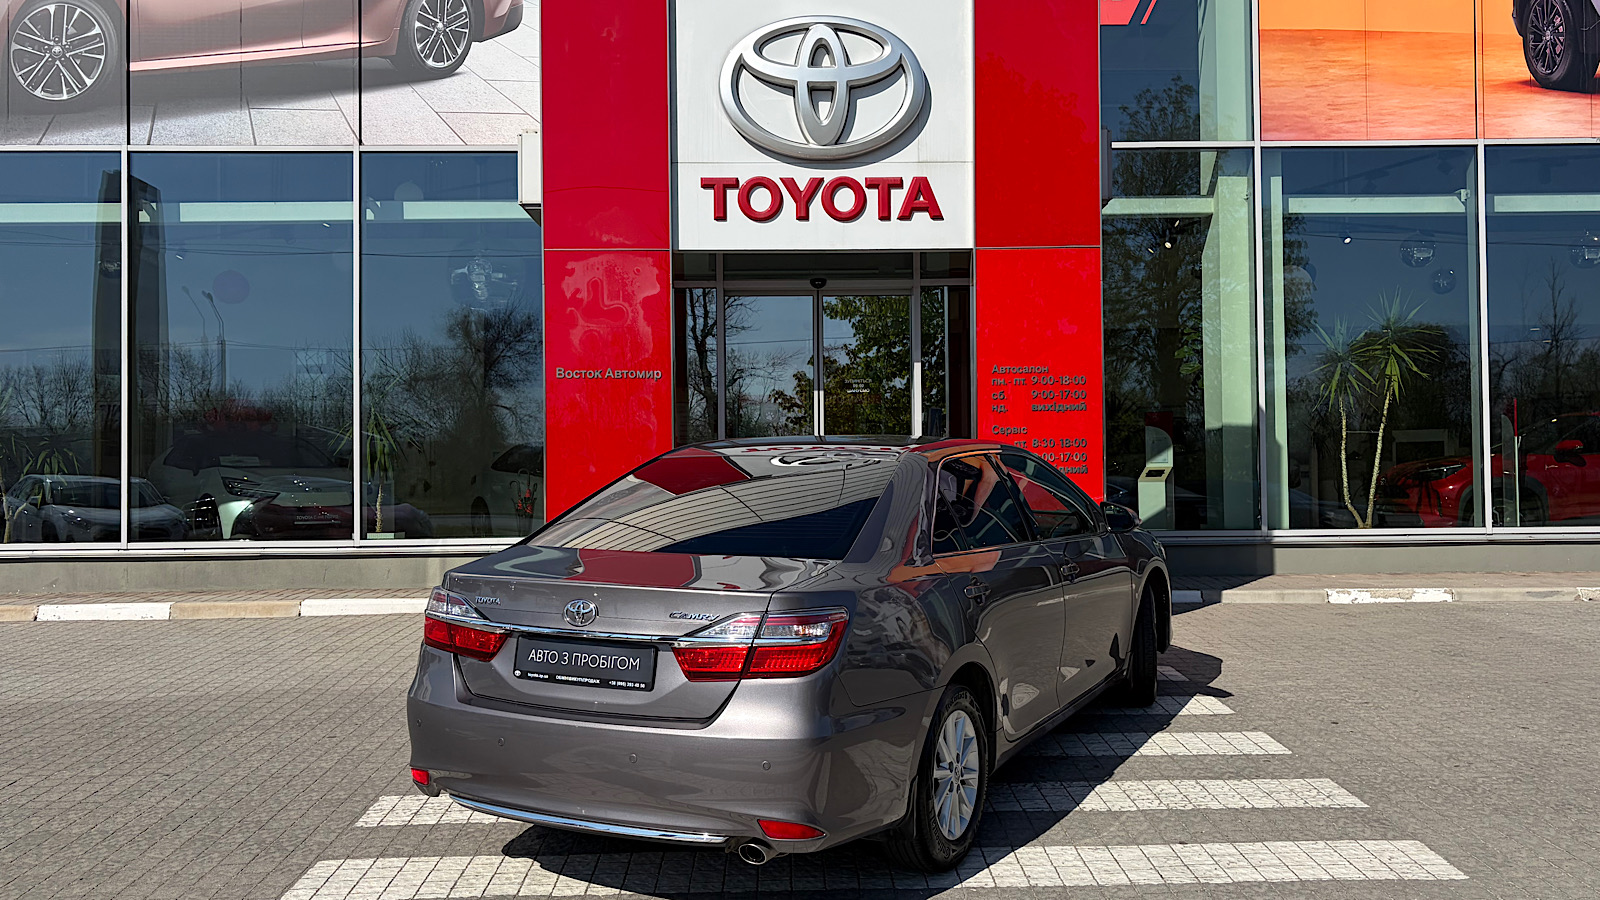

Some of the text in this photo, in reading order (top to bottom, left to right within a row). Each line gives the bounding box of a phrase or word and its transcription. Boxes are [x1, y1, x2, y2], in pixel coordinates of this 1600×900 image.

[700, 176, 944, 223] TOYOTA
[556, 367, 662, 381] Восток Автомир
[992, 364, 1049, 374] Автосалон
[1031, 375, 1087, 386] 9:00-18:00
[992, 390, 1087, 400] сб. 9:00-17:00
[992, 401, 1087, 413] нд. вихідний
[992, 425, 1028, 436] Сервіс
[1034, 452, 1087, 462] :00-17:00
[475, 595, 501, 606] TOYOTA
[669, 611, 720, 622] CAMRY
[528, 648, 559, 664] АВТО
[572, 652, 640, 671] ПРОБІГОМ
